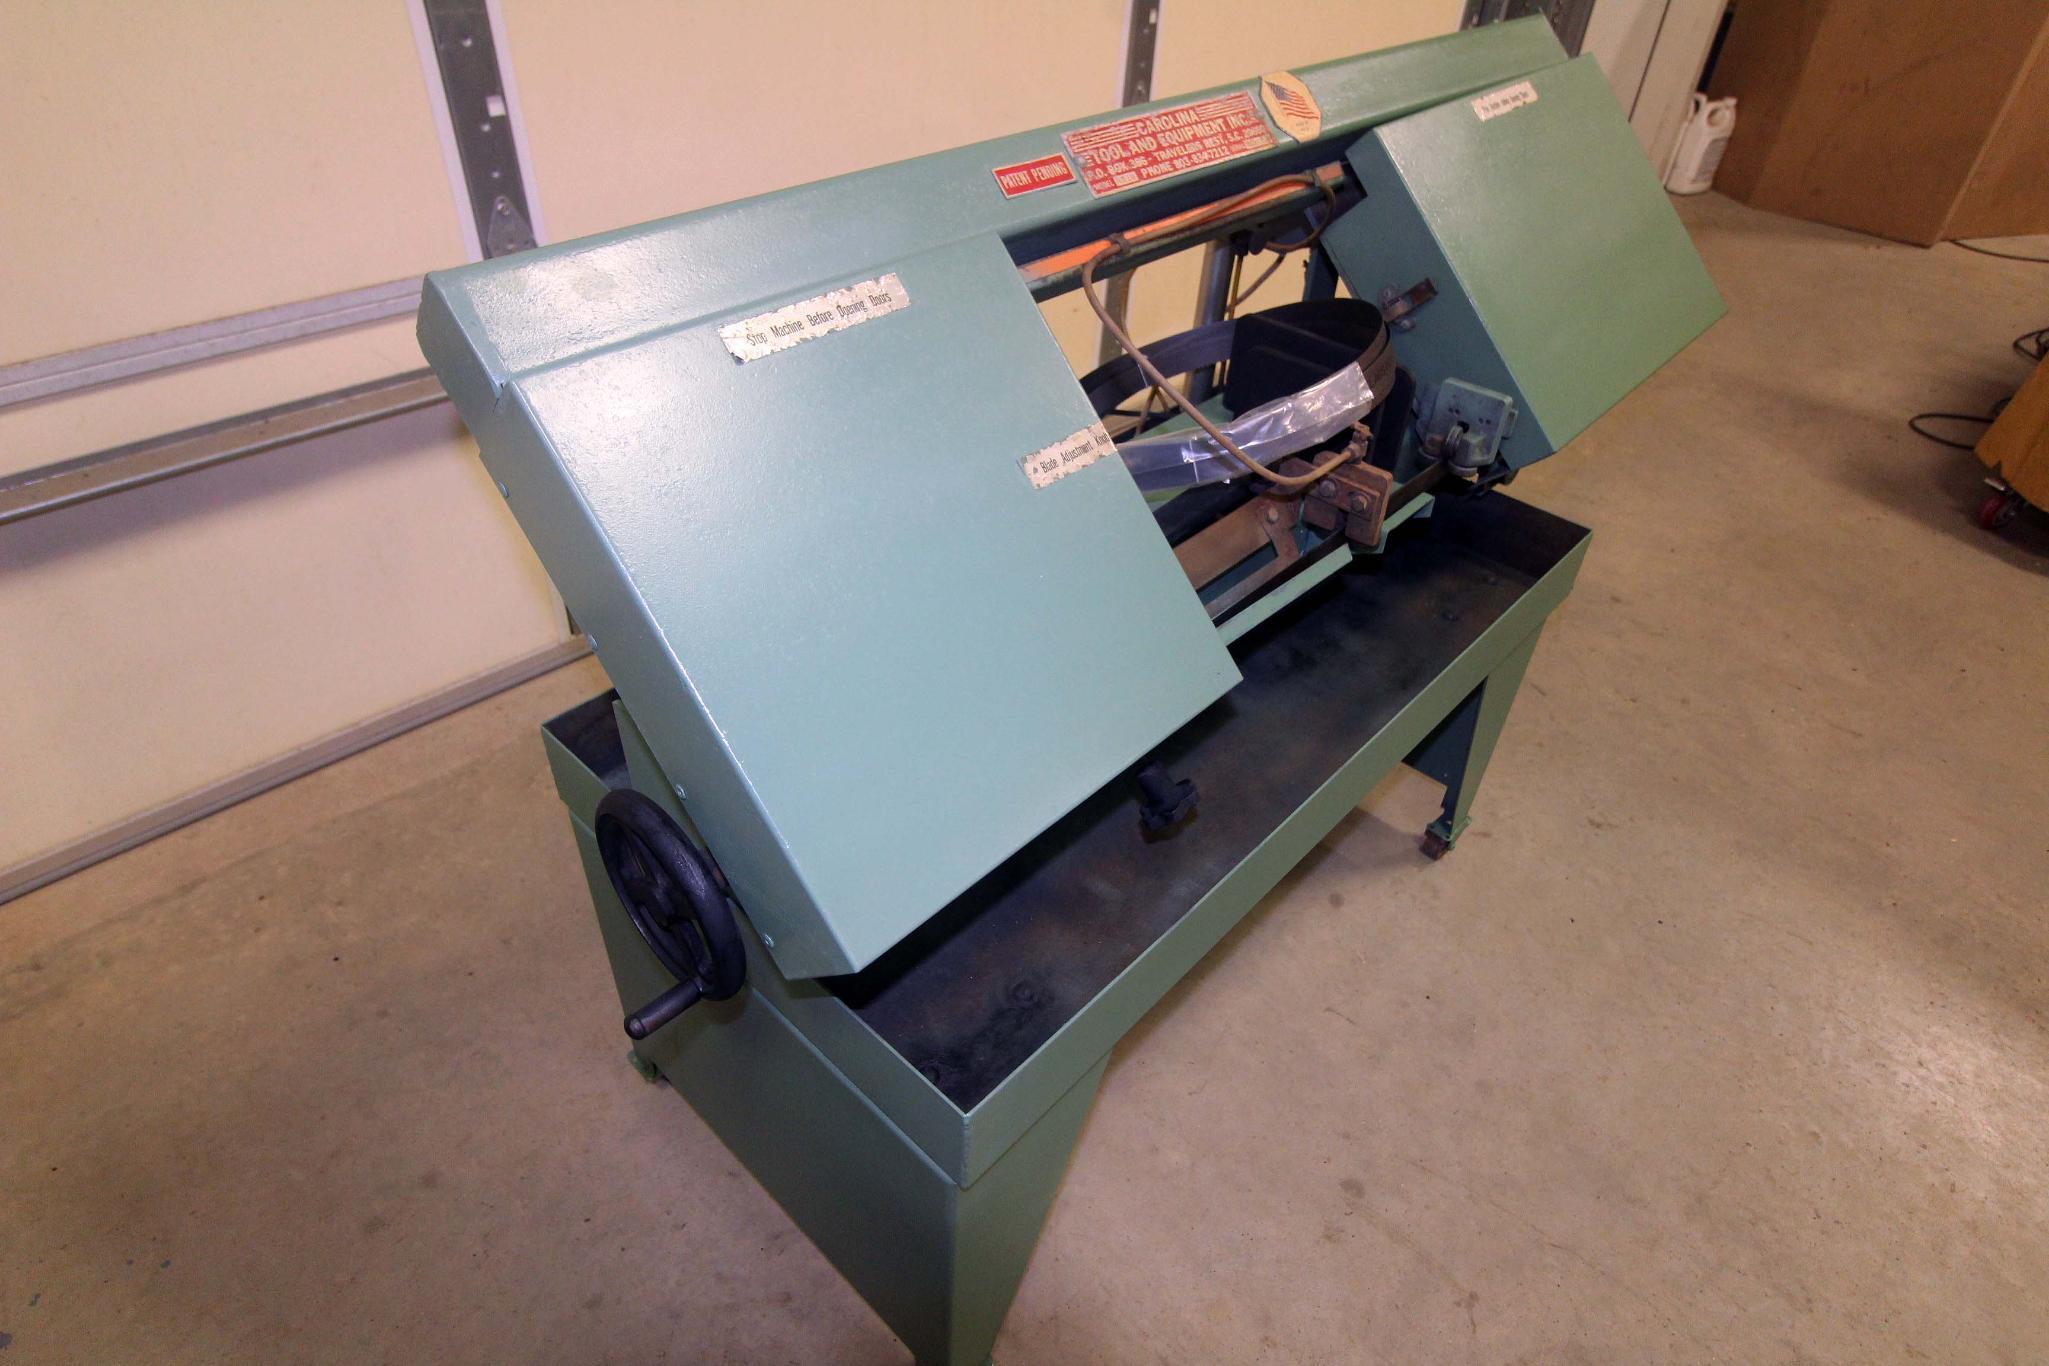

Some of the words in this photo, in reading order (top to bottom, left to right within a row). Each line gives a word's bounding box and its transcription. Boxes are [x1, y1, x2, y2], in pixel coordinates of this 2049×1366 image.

[1136, 109, 1200, 135] CAROLINA
[1092, 143, 1131, 164] TOOL
[1128, 136, 1158, 155] AND
[1157, 118, 1227, 147] EQUIPMENT
[1000, 171, 1031, 189] PATENT
[1031, 162, 1068, 182] PENDING
[1107, 162, 1128, 175] BOX
[1140, 162, 1174, 179] PHONE
[746, 331, 767, 346] Stop
[770, 319, 804, 338] Machine
[806, 310, 833, 327] Before
[836, 300, 868, 317] Opening
[868, 292, 892, 307] Doors
[1040, 457, 1059, 473] Blade
[1060, 441, 1094, 464] Adjustment
